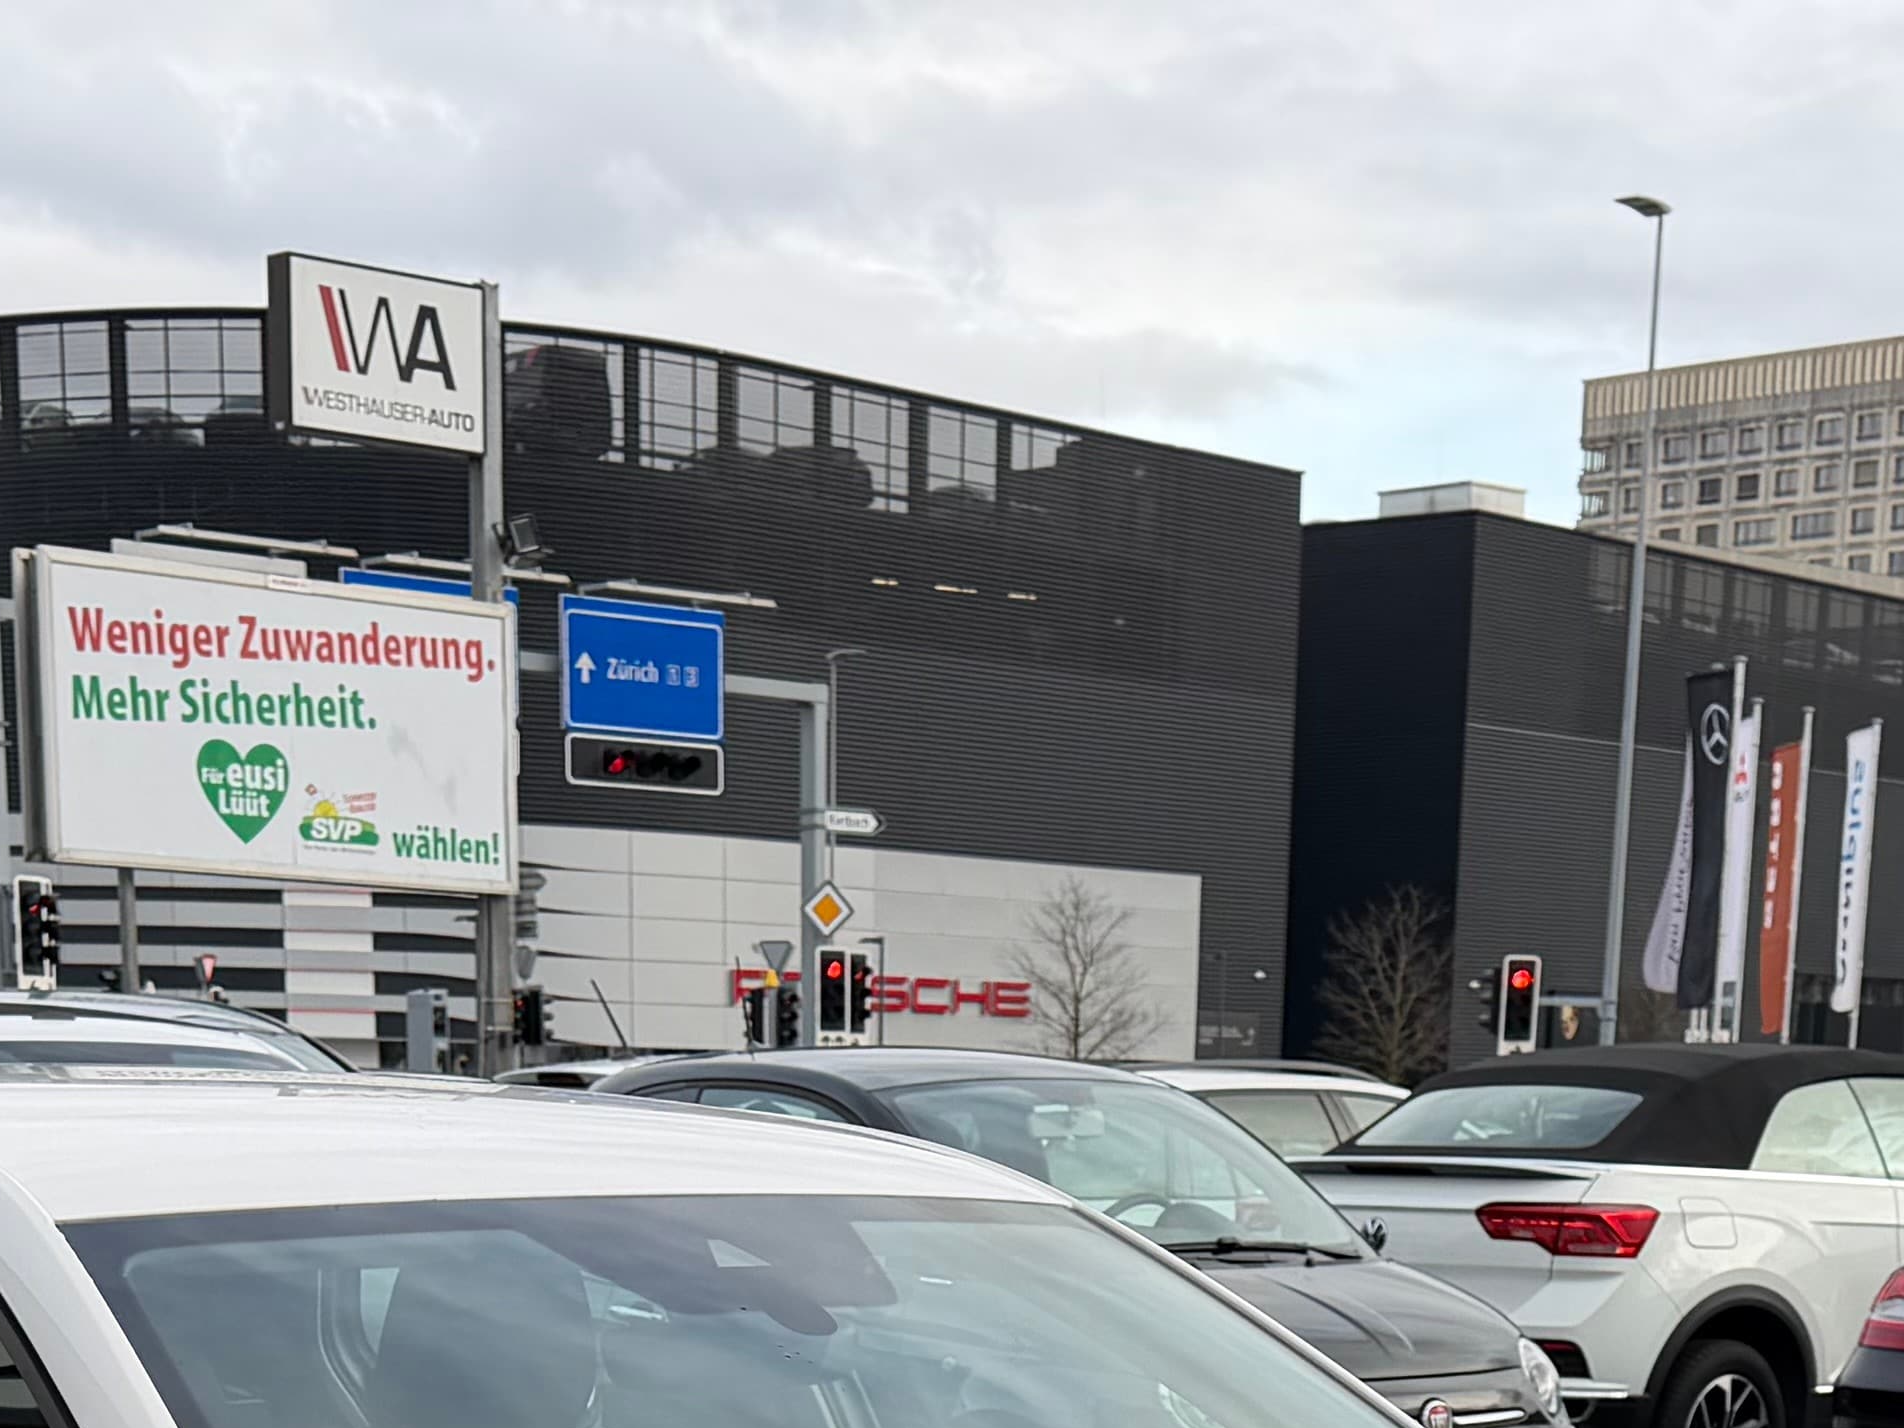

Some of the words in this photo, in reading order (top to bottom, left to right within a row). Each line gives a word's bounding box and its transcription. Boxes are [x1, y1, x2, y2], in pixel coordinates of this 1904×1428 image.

[302, 386, 475, 432] WESTHAUSER-AUTO
[68, 606, 230, 668] Weniger
[238, 615, 495, 683] Zuwanderung.
[606, 656, 659, 683] Zürich
[72, 675, 169, 721] Mehr
[179, 678, 376, 729] Sicherheit.
[226, 758, 285, 792] eusi
[219, 788, 270, 817] Lüüt
[310, 817, 363, 842] SVP
[393, 825, 499, 865] wählen!
[732, 969, 1032, 1017] PSCHE
